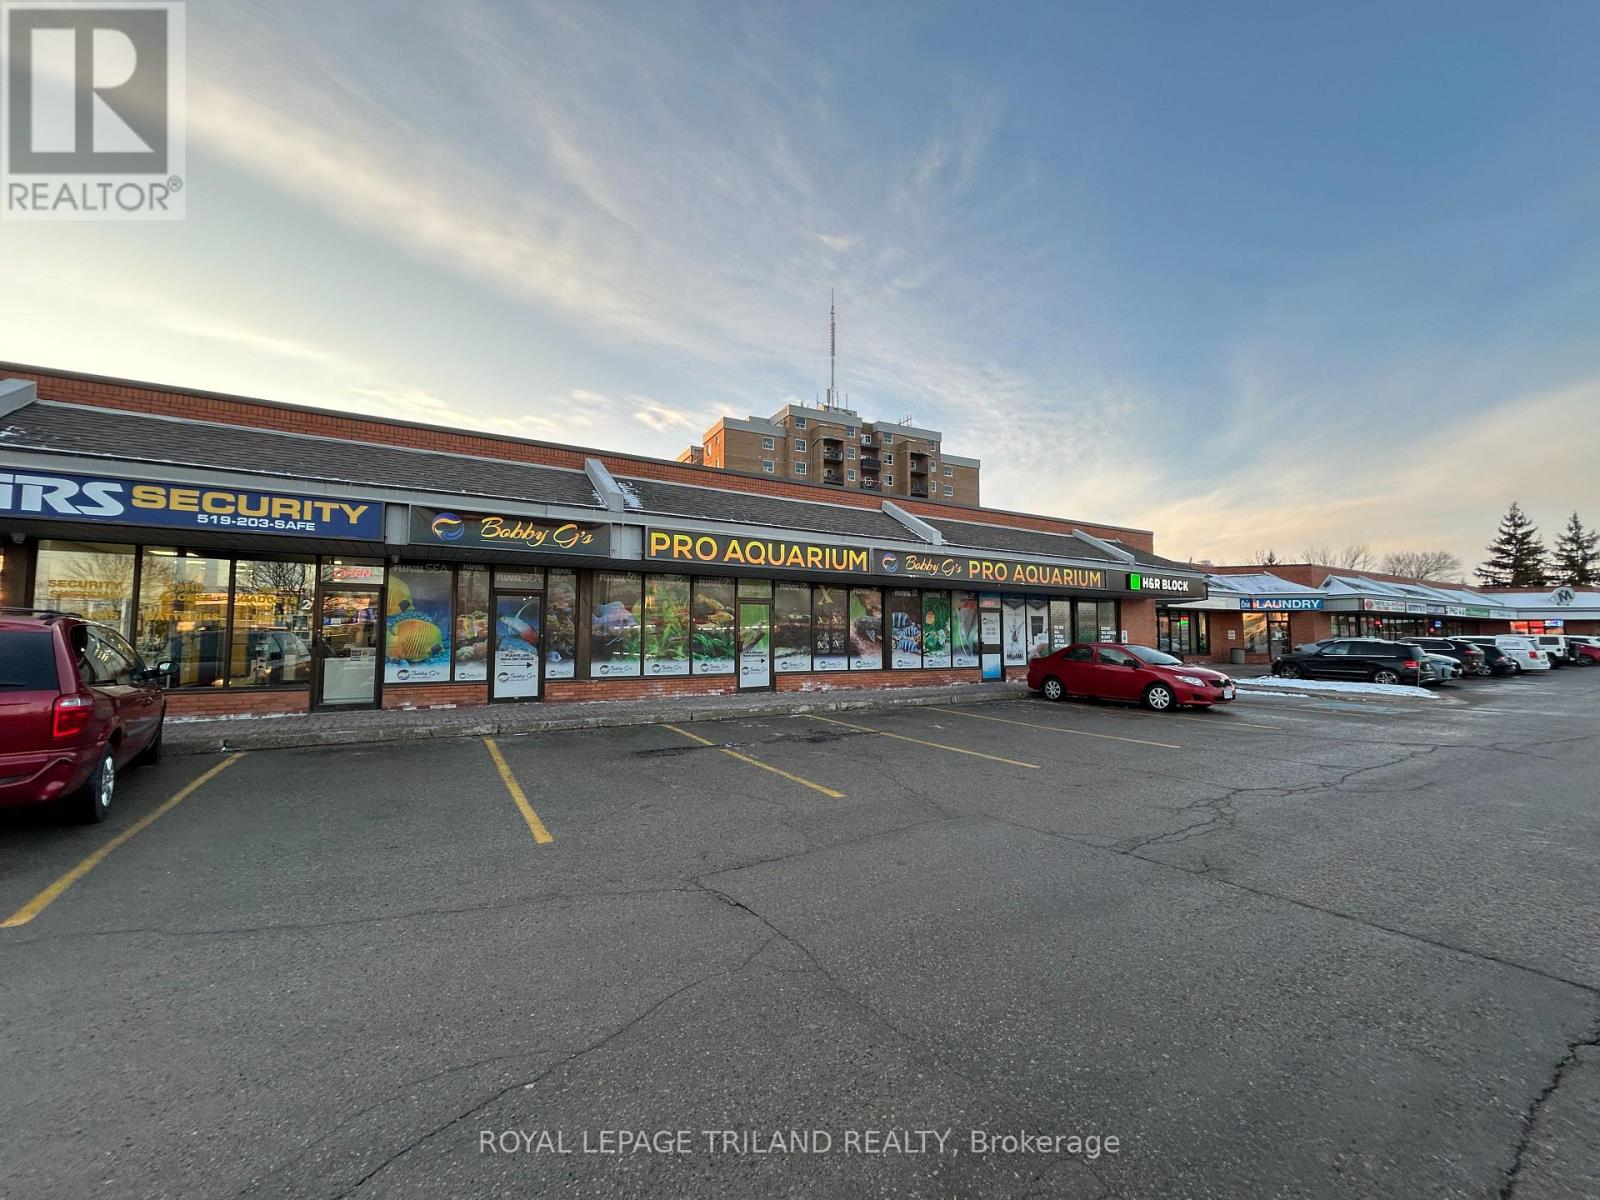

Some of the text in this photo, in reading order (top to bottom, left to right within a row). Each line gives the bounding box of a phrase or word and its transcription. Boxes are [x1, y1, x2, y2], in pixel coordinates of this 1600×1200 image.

[132, 485, 368, 524] SECURITY
[197, 514, 316, 531] 519-203-SAFE
[481, 516, 549, 547] Bobby
[650, 532, 867, 571] PRO AQUARIUM
[905, 555, 940, 576] Bobby
[968, 560, 1008, 581] PRO
[1013, 564, 1101, 588] AQUARIUM
[48, 580, 122, 589] SECURITY
[1142, 577, 1189, 591] H&R BLOCK
[1257, 599, 1320, 609] LAUNDRY
